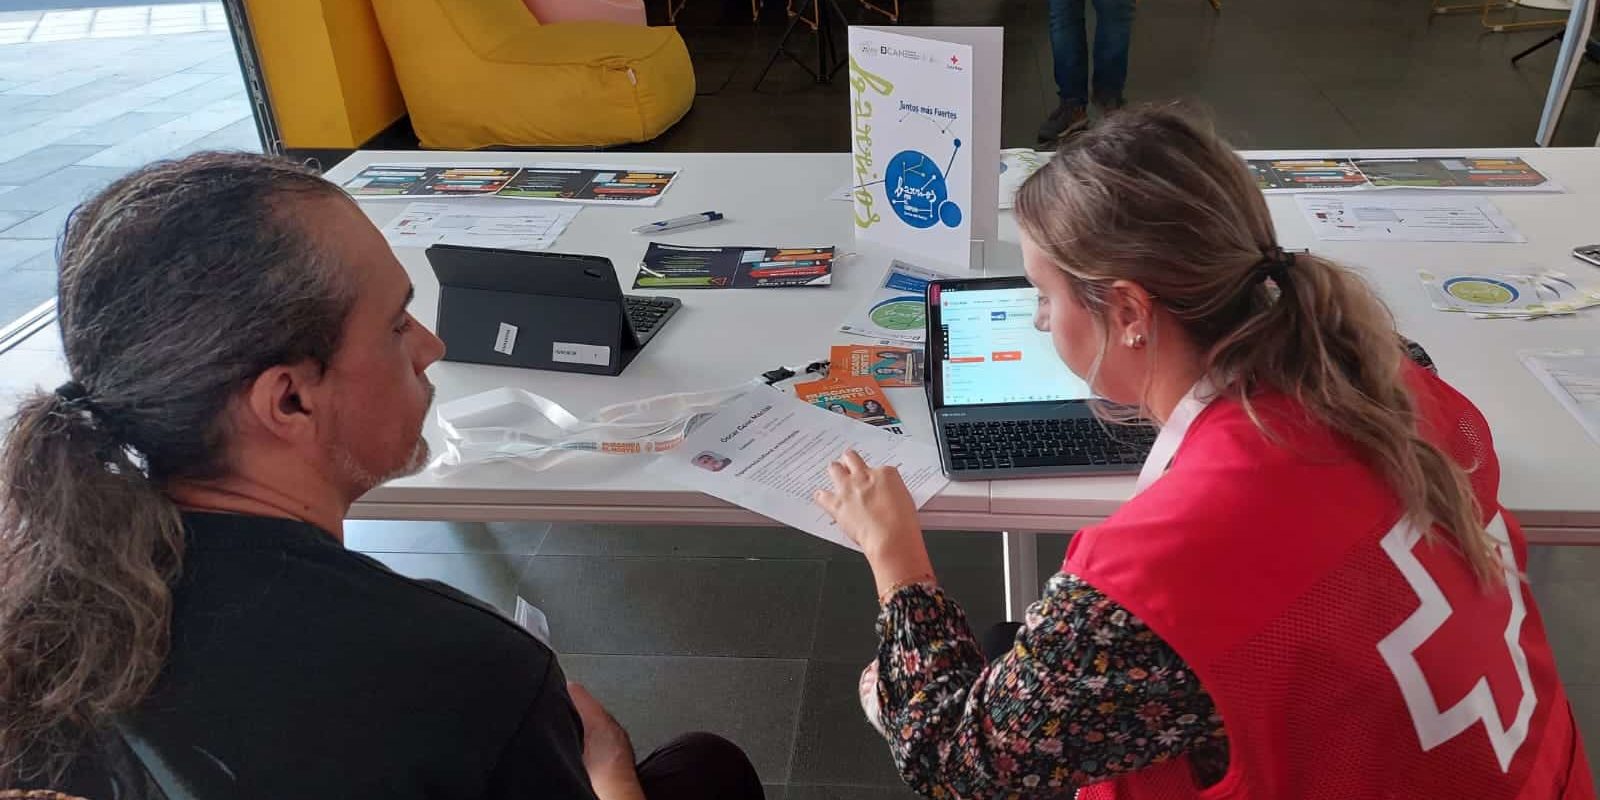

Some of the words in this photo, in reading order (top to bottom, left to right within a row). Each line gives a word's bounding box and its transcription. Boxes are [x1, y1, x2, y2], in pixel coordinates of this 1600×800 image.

[899, 101, 919, 113] Juntos
[920, 104, 933, 115] más
[934, 108, 957, 120] Fuertes
